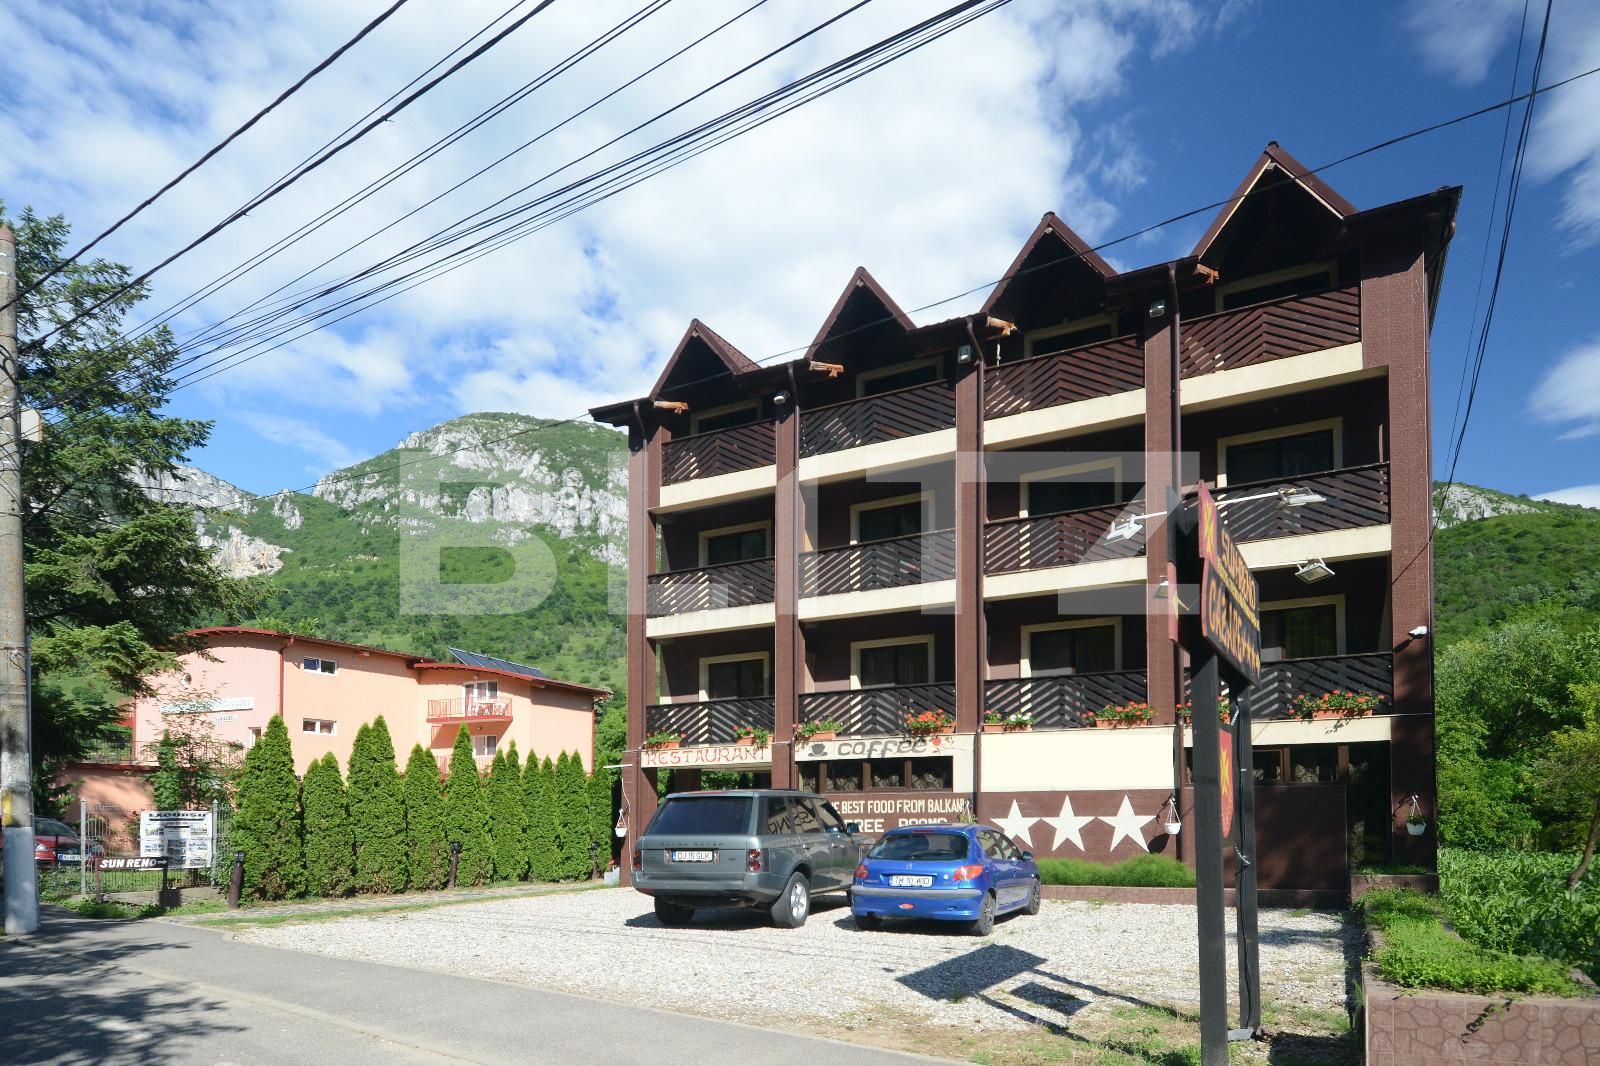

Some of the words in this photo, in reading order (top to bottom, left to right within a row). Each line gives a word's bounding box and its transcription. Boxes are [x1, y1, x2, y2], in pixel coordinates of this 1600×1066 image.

[646, 744, 769, 766] RESTAURANT
[841, 800, 866, 814] BEST
[867, 800, 895, 814] FOOD
[896, 799, 926, 814] FROM
[100, 859, 125, 868] SUN
[126, 858, 157, 867] RENO
